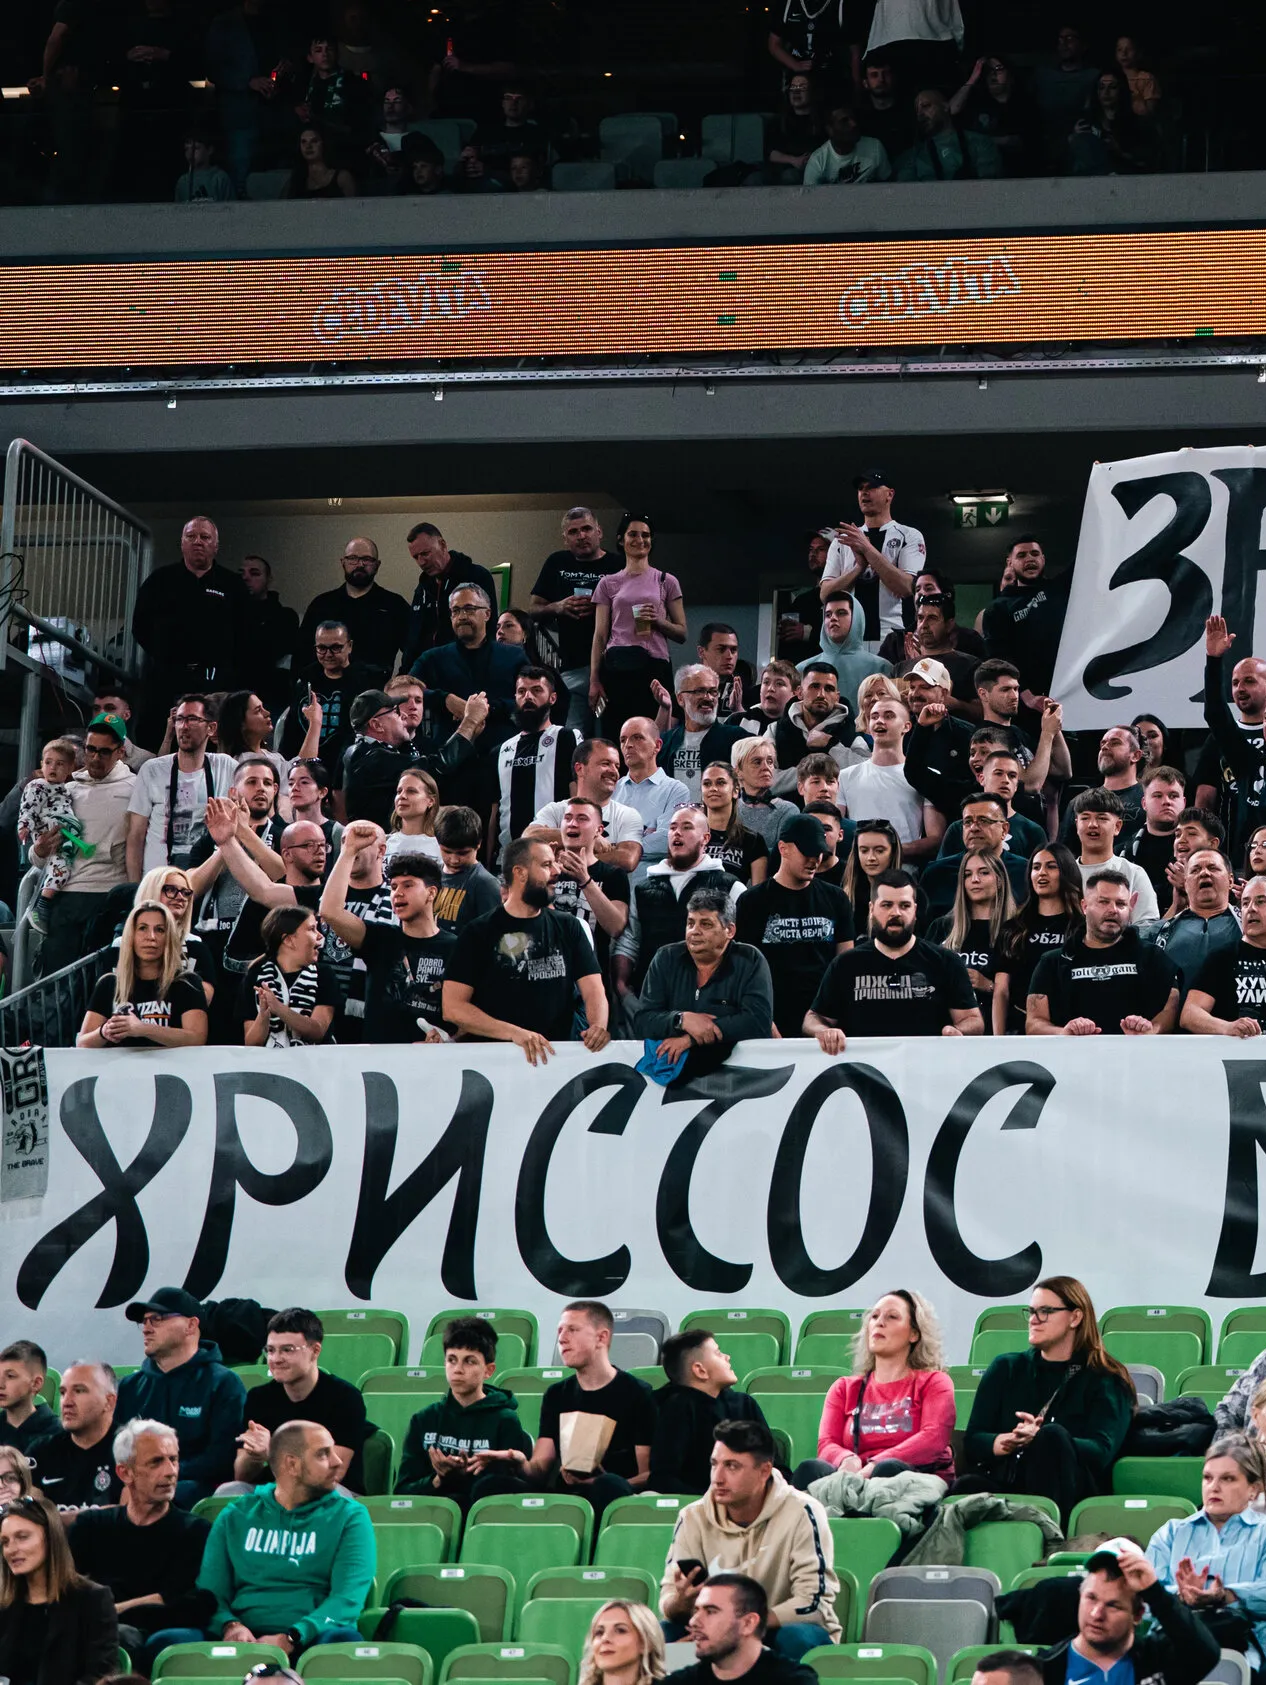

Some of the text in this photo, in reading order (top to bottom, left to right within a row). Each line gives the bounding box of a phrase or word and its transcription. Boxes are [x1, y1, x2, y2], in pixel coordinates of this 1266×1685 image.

[839, 256, 1021, 329] CEDEVITA
[313, 271, 492, 344] CEDEVITA
[703, 845, 744, 859] RTIZAN
[419, 957, 444, 968] DOBRO
[855, 974, 912, 989] ЈУЖА
[137, 1000, 172, 1016] TIZAN
[17, 1057, 1057, 1311] ХРИСТОС
[424, 1432, 458, 1447] CEDVITA
[459, 1439, 490, 1449] OLIPIJA
[245, 1527, 316, 1556] OLIMPIJA
